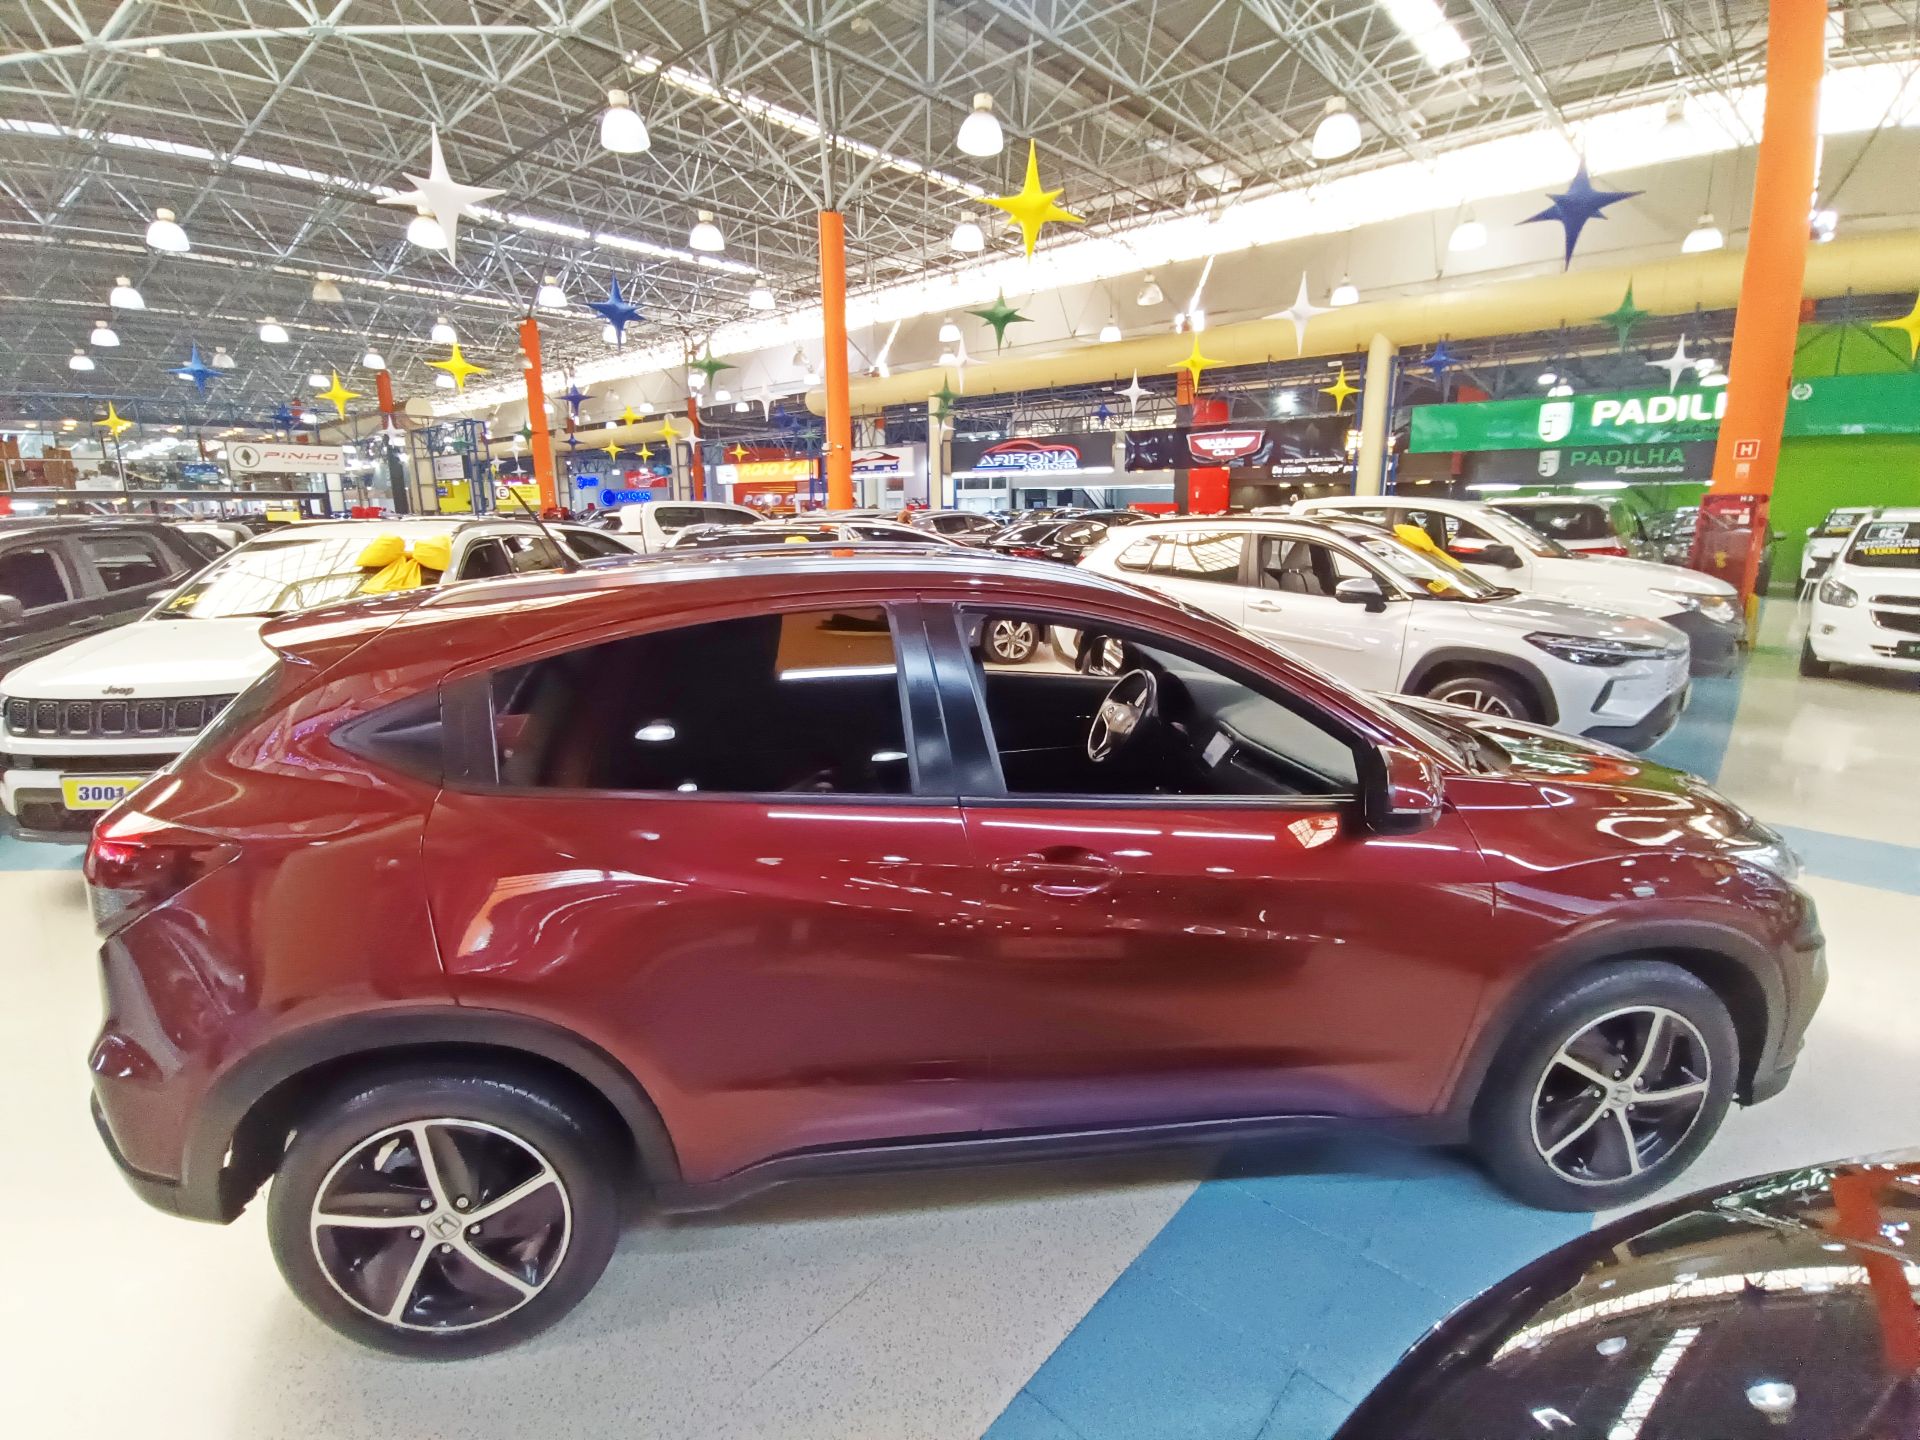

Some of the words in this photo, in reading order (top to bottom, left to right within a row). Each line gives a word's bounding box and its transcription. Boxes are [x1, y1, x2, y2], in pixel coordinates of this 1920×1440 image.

[1591, 392, 1728, 427] PADIL
[1740, 444, 1753, 456] H
[976, 450, 1076, 467] ARIZONA
[1570, 447, 1685, 466] PADILHA
[741, 463, 780, 476] ROJO
[743, 494, 782, 506] ROO
[1878, 527, 1903, 539] 16
[102, 686, 135, 696] Jeep
